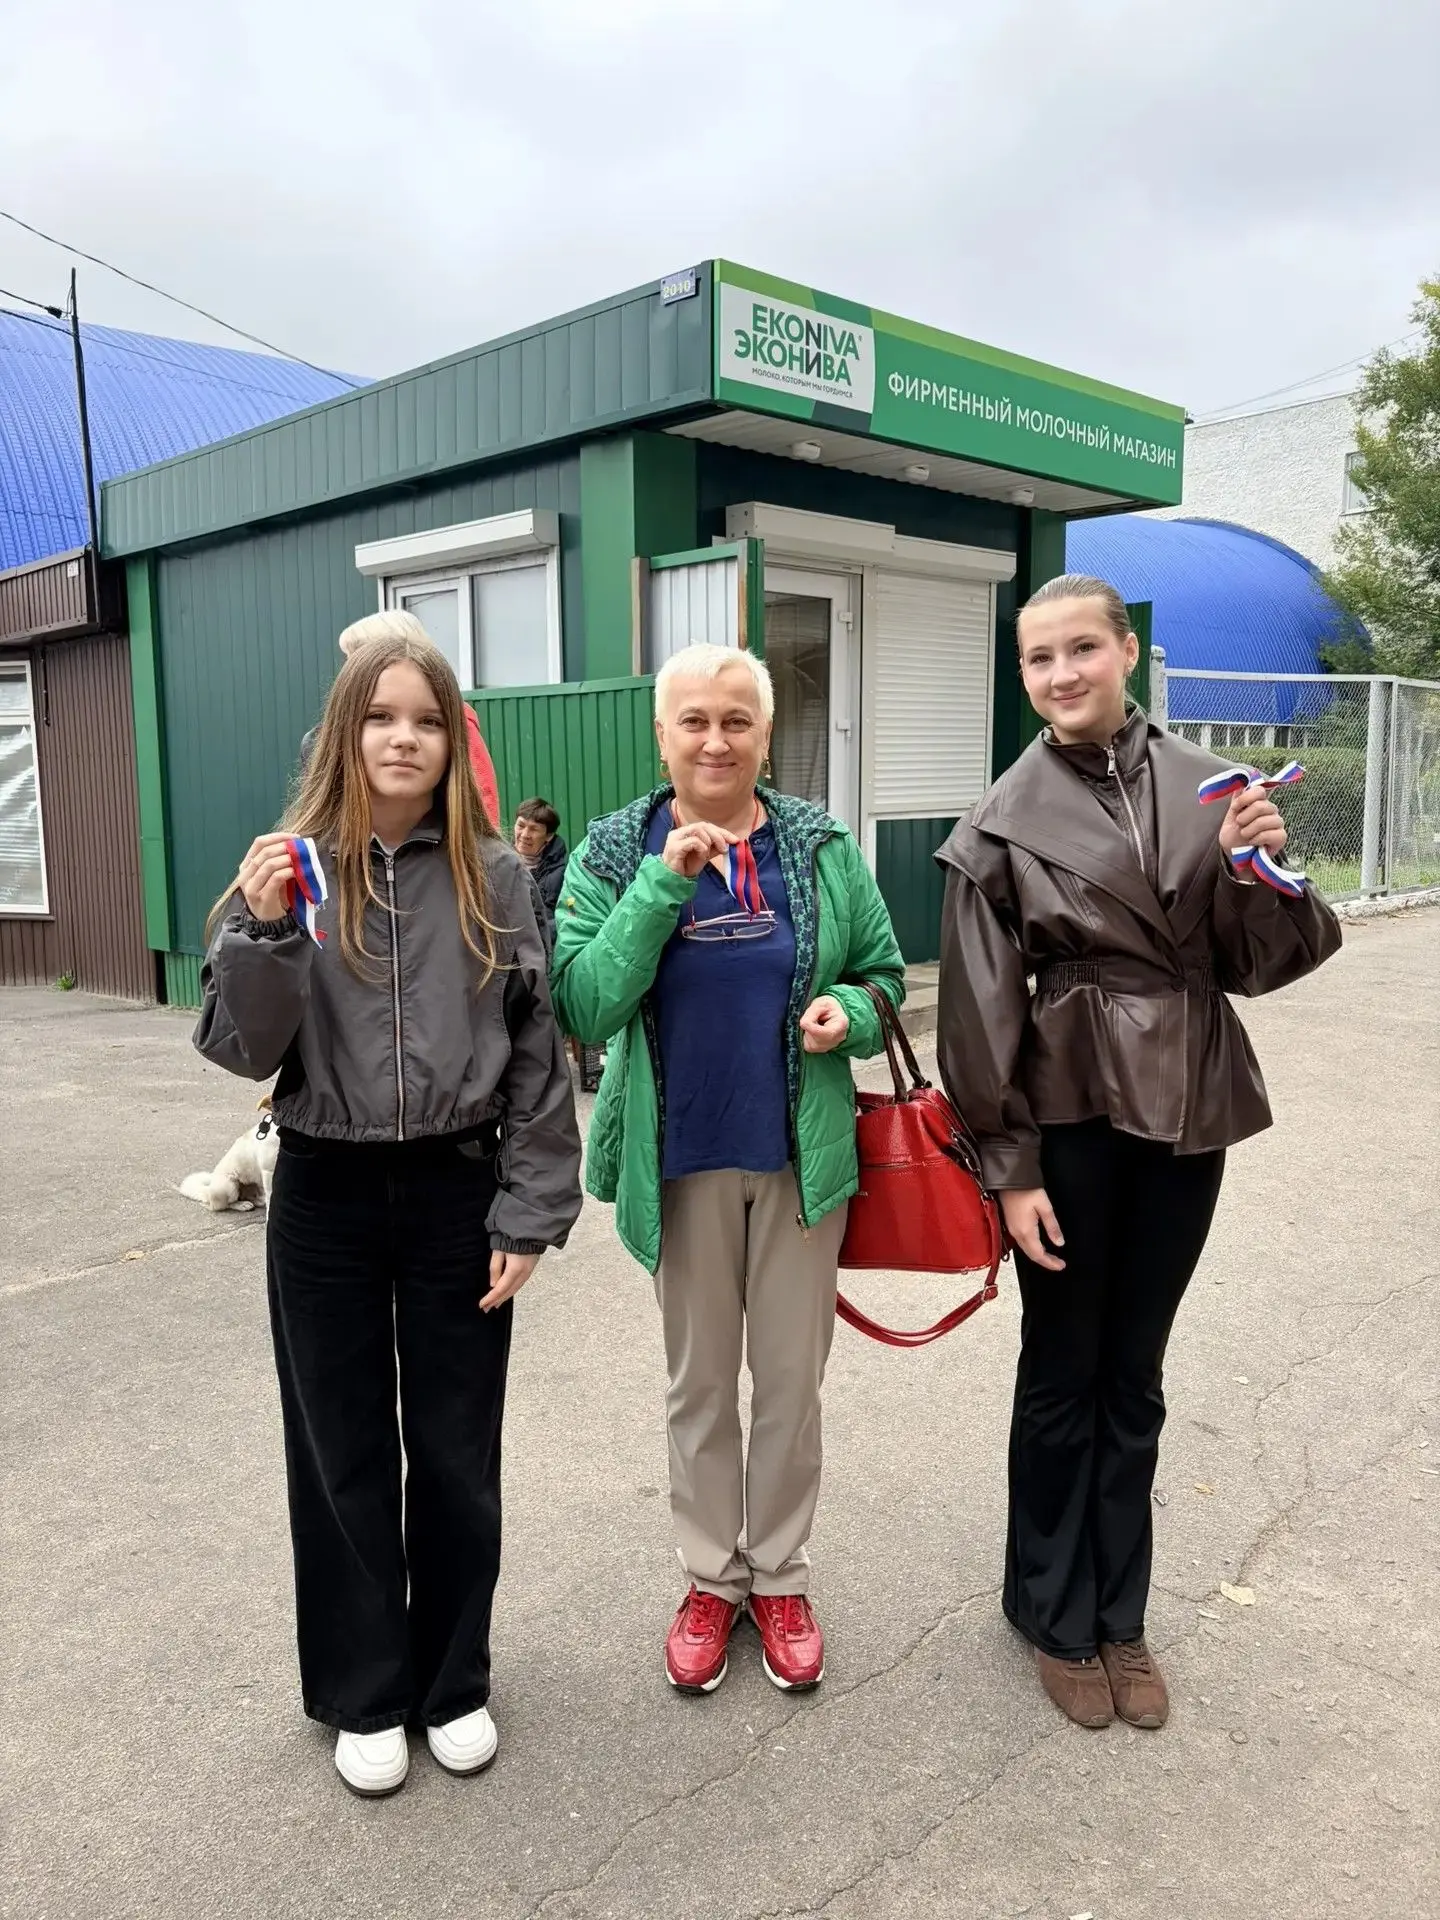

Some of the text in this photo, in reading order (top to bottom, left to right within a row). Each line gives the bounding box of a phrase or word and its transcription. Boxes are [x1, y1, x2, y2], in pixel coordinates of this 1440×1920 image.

[734, 329, 852, 386] ЭКОНИВА
[752, 303, 860, 361] EKONIVA
[782, 375, 812, 389] КОТОРЫМ
[812, 382, 822, 391] МЫ
[822, 385, 853, 399] ГОРДИМСЯ
[888, 372, 1176, 469] ФИРМЕННЫЙ МОЛОЧНЫЙ МАГАЗИН
